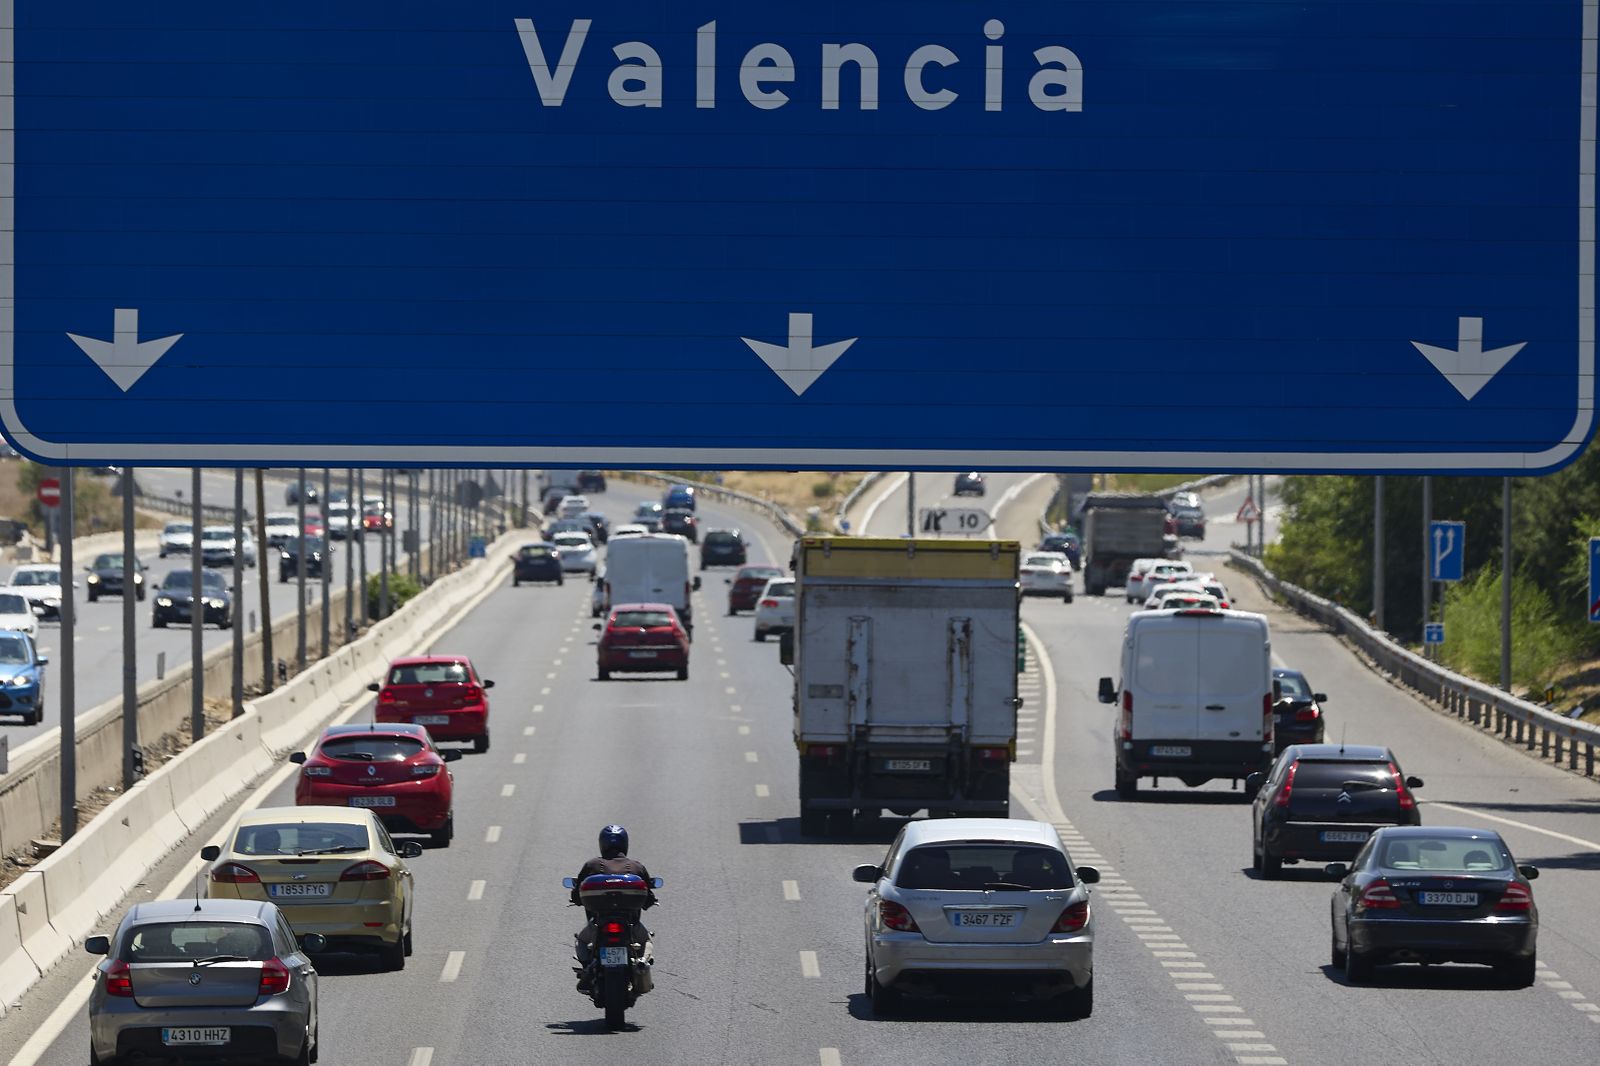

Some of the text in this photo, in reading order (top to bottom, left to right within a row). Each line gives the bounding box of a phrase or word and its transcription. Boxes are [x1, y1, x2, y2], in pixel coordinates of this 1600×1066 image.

[513, 18, 1083, 112] Valencia
[960, 513, 978, 528] 10
[280, 884, 325, 895] 1853 FYG
[1426, 893, 1476, 904] 3370 DJM
[962, 914, 1013, 925] 3467 FZF
[171, 1029, 228, 1041] 4310 HHZ
